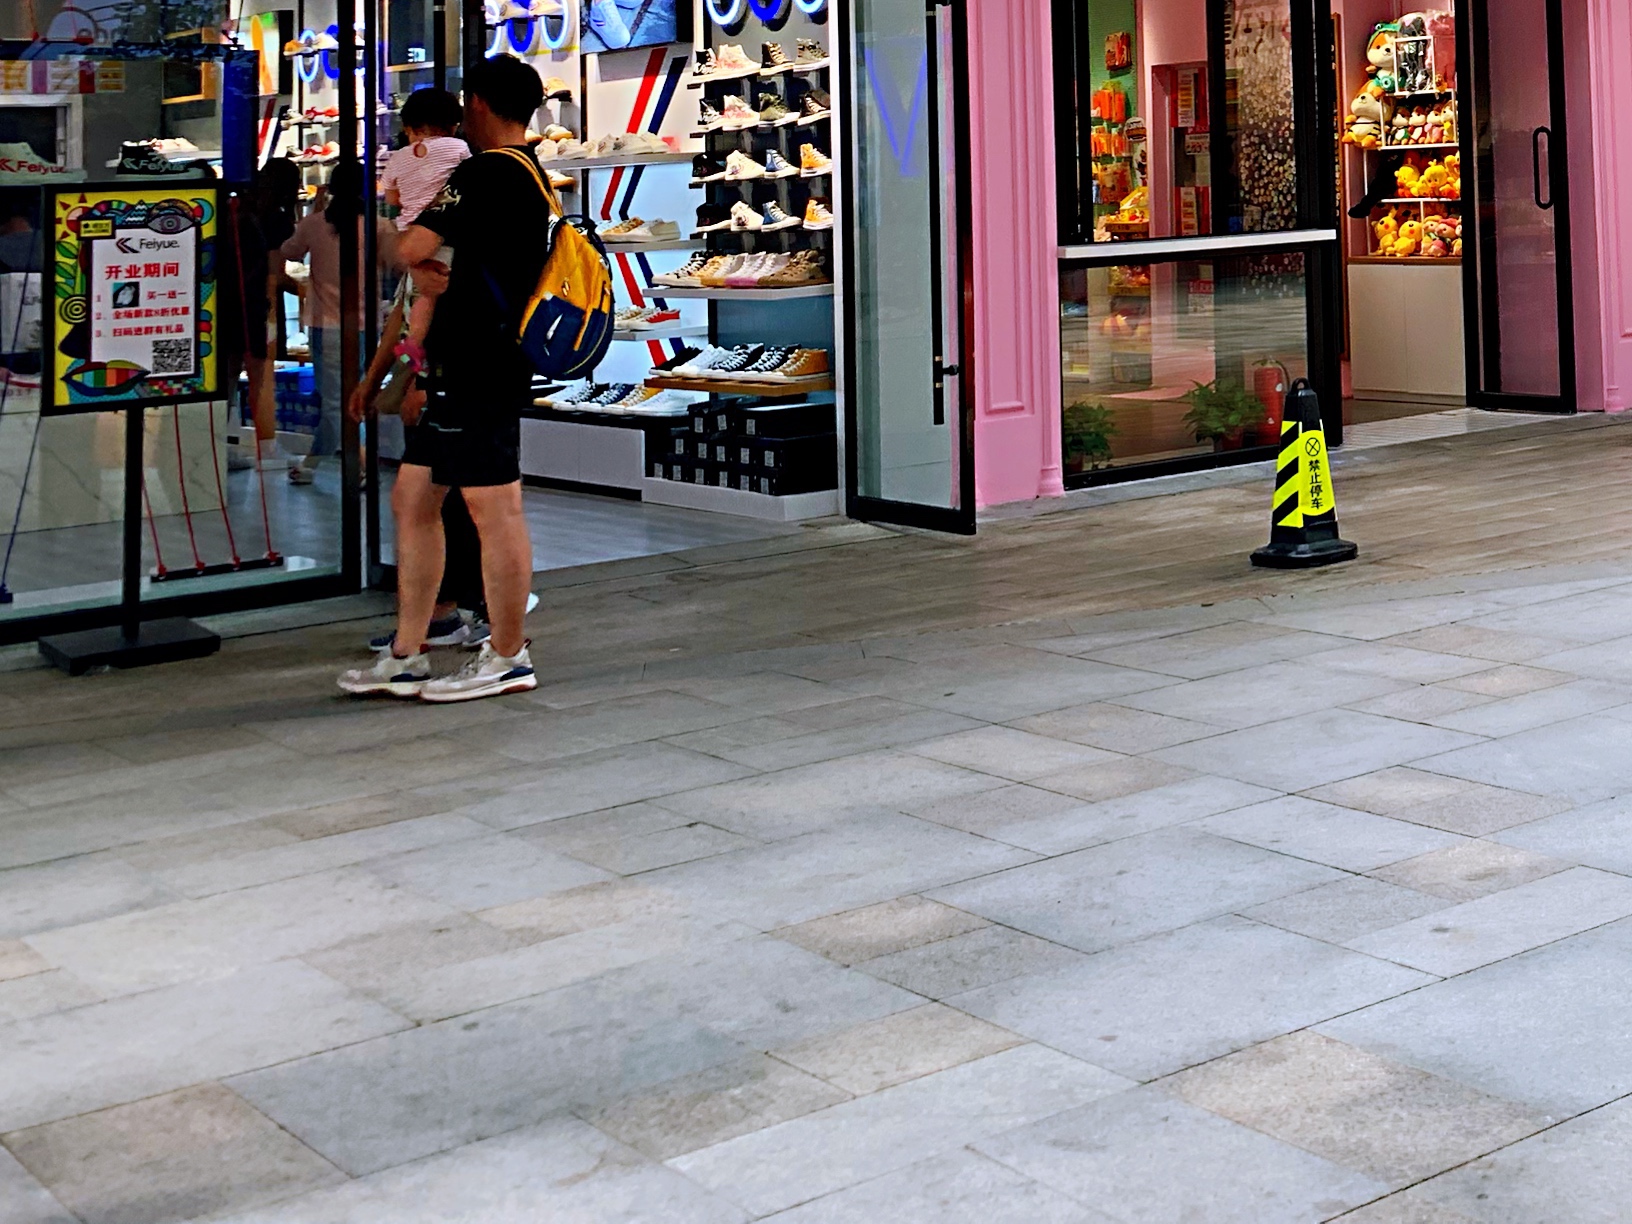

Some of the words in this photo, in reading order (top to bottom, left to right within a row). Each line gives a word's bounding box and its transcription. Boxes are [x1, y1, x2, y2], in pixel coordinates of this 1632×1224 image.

[105, 262, 179, 280] 开业期间
[1308, 459, 1324, 510] 禁止停车
